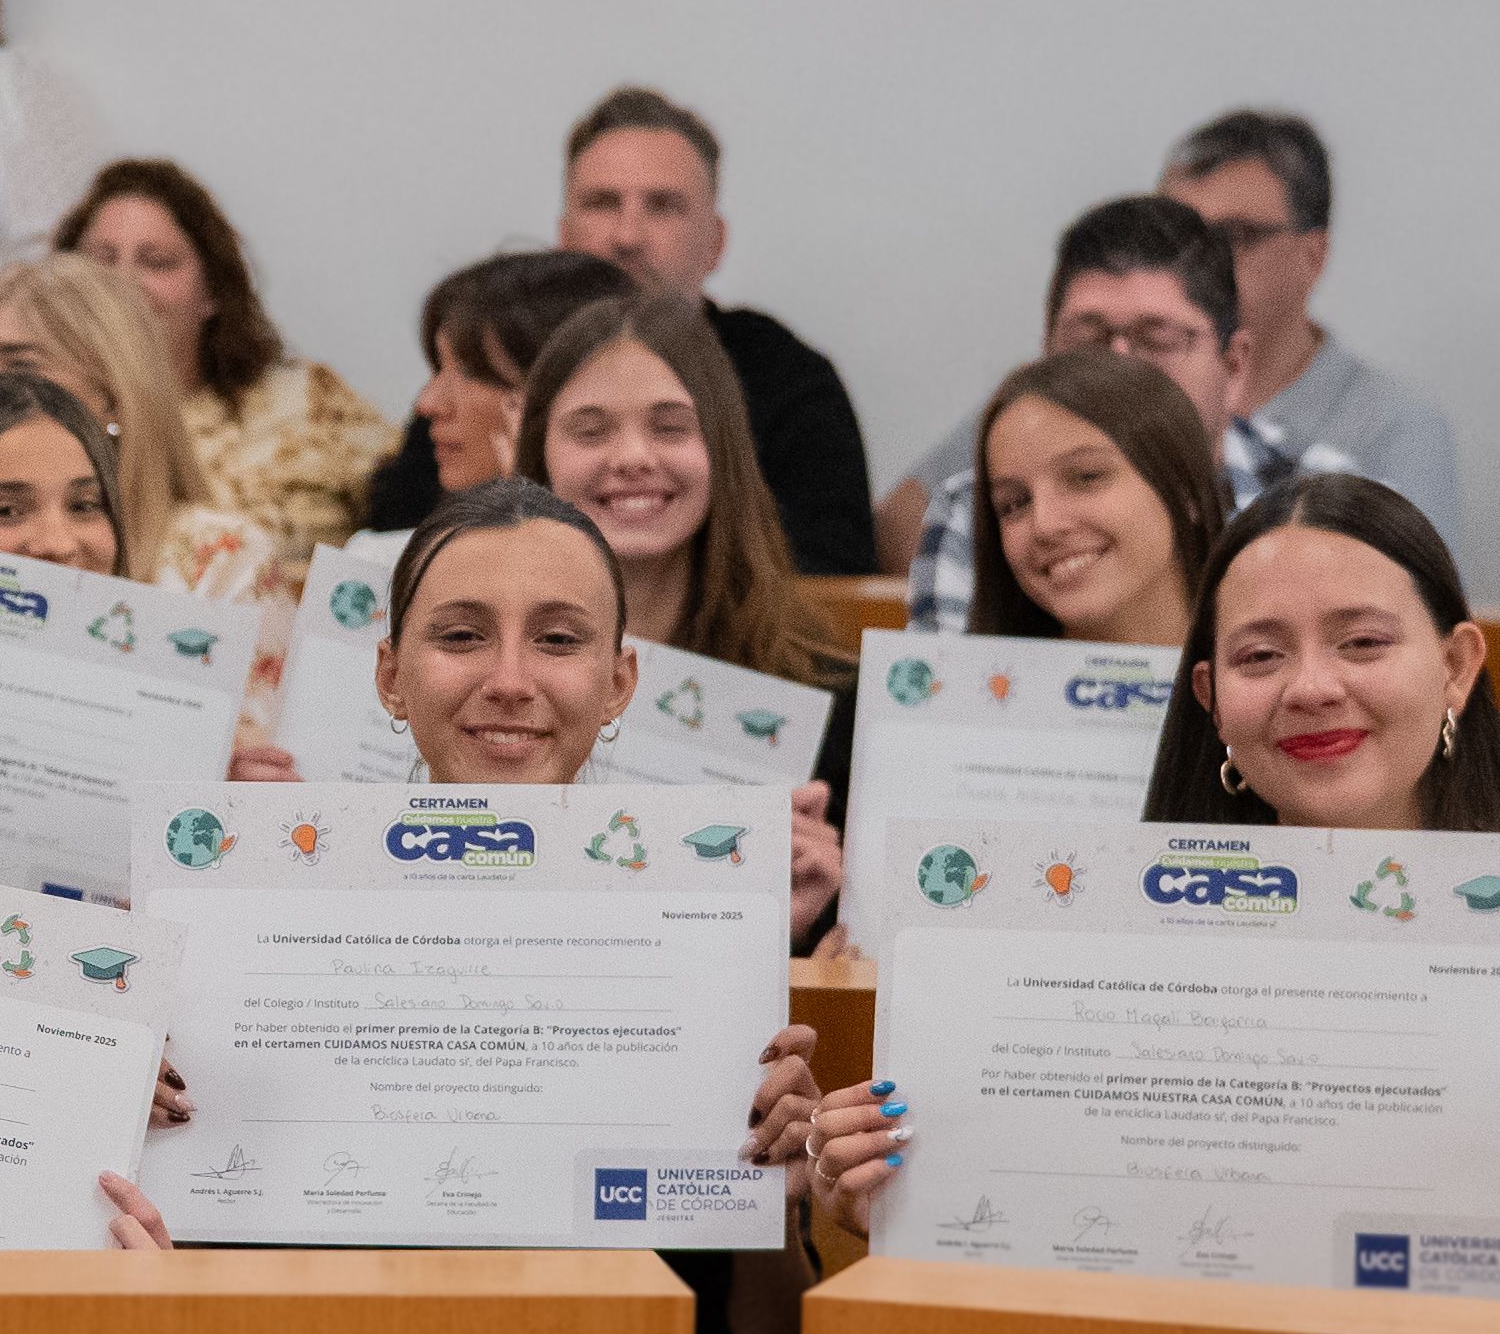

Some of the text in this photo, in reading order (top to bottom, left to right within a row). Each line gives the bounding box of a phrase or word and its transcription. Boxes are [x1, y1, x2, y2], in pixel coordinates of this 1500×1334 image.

[409, 797, 488, 808] CERTAMEN
[385, 820, 535, 861] casa
[1167, 838, 1250, 851] CERTAMEN
[464, 851, 531, 866] común
[1142, 864, 1298, 905] casa
[1224, 896, 1294, 913] común
[662, 911, 743, 920] Noviembre 2025
[256, 933, 662, 949] La Universidad Católica de Córdoba otorga el presente reconocimiento a
[36, 1023, 117, 1047] Noviembre 2025
[24, 1049, 31, 1059] a
[657, 1168, 763, 1181] UNIVERSIDAD
[599, 1185, 642, 1203] UCC
[656, 1181, 731, 1195] CATÓLICA
[656, 1196, 757, 1211] DE CÓRDOBA
[1359, 1250, 1405, 1271] UCC
